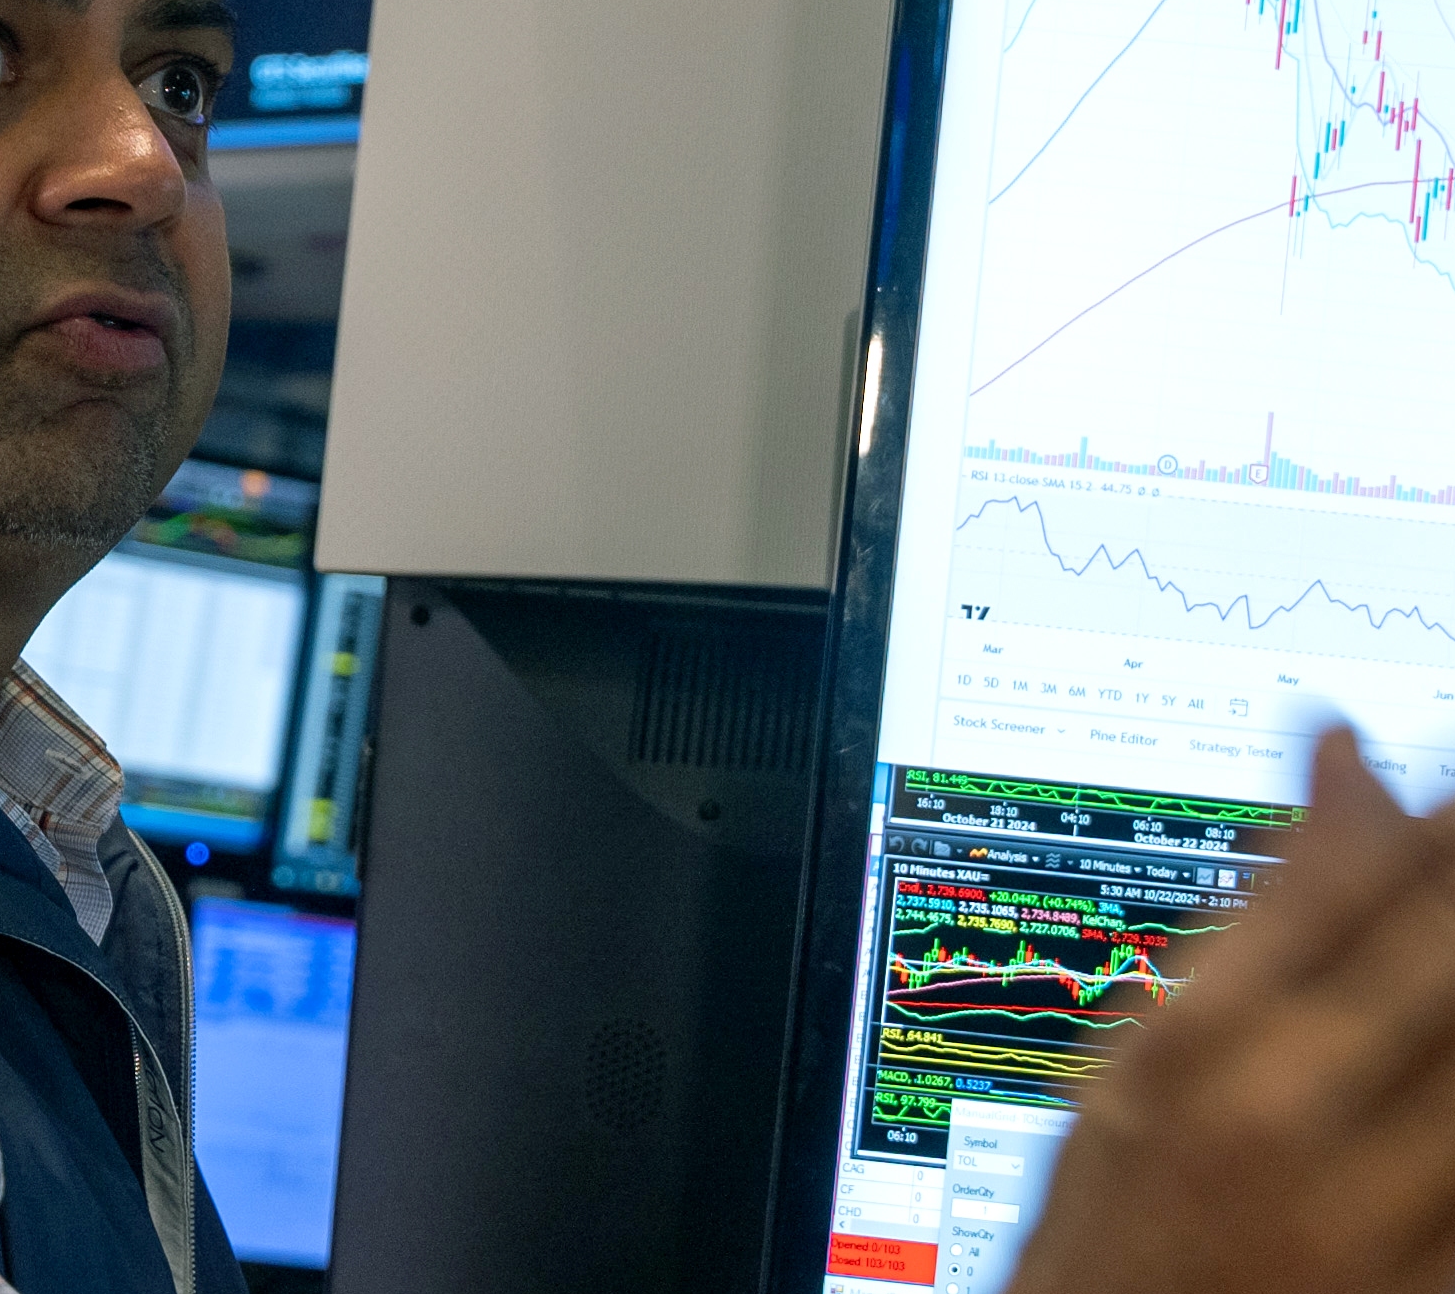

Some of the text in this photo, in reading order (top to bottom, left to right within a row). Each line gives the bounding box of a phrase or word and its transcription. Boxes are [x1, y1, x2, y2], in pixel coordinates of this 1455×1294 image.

[971, 470, 1132, 494] RSI 13 close SMA 44.75
[982, 643, 1004, 655] Mar
[1123, 658, 1144, 670] Apr
[1277, 673, 1300, 687] May
[1432, 689, 1455, 701] Jun
[956, 674, 1205, 709] 1D 5D 1M 3M 6M YTD 1Y 5Y All
[953, 715, 987, 729] Stock
[991, 718, 1046, 735] Screener
[1090, 729, 1117, 742] Pine
[1120, 732, 1159, 747] Editor
[1188, 739, 1241, 758] Strategy
[1246, 744, 1284, 759] Tester
[916, 798, 1235, 840] 16:10 18:10 04:10 06:10 08:10
[942, 813, 1229, 852] October 21 2024 October 22 2024
[987, 849, 1028, 863] Analysis
[893, 862, 989, 882] 10 Minutes XAU=
[1079, 858, 1132, 875] 10 Minutes
[1146, 865, 1178, 880] Today
[1100, 884, 1231, 908] 5:30 AM 10/22/2024 2:10
[958, 901, 1018, 917] 2,735.1065,
[1019, 921, 1080, 938] 2,727.0706,
[882, 1027, 904, 1041] RSI,
[955, 1078, 991, 1091] 0.5237
[887, 1129, 918, 1143] 06:10
[964, 1136, 998, 1150] Symbol
[957, 1155, 978, 1167] TOL
[842, 1162, 924, 1181] CAG 0
[840, 1184, 922, 1202] CF 0
[952, 1183, 995, 1199] OrderQty
[838, 1205, 919, 1225] CHD 0
[952, 1226, 995, 1242] ShowQty
[831, 1237, 901, 1255] Opened 0/103
[968, 1247, 980, 1257] All
[829, 1253, 906, 1271] Closed 103/103
[966, 1266, 973, 1277] 0
